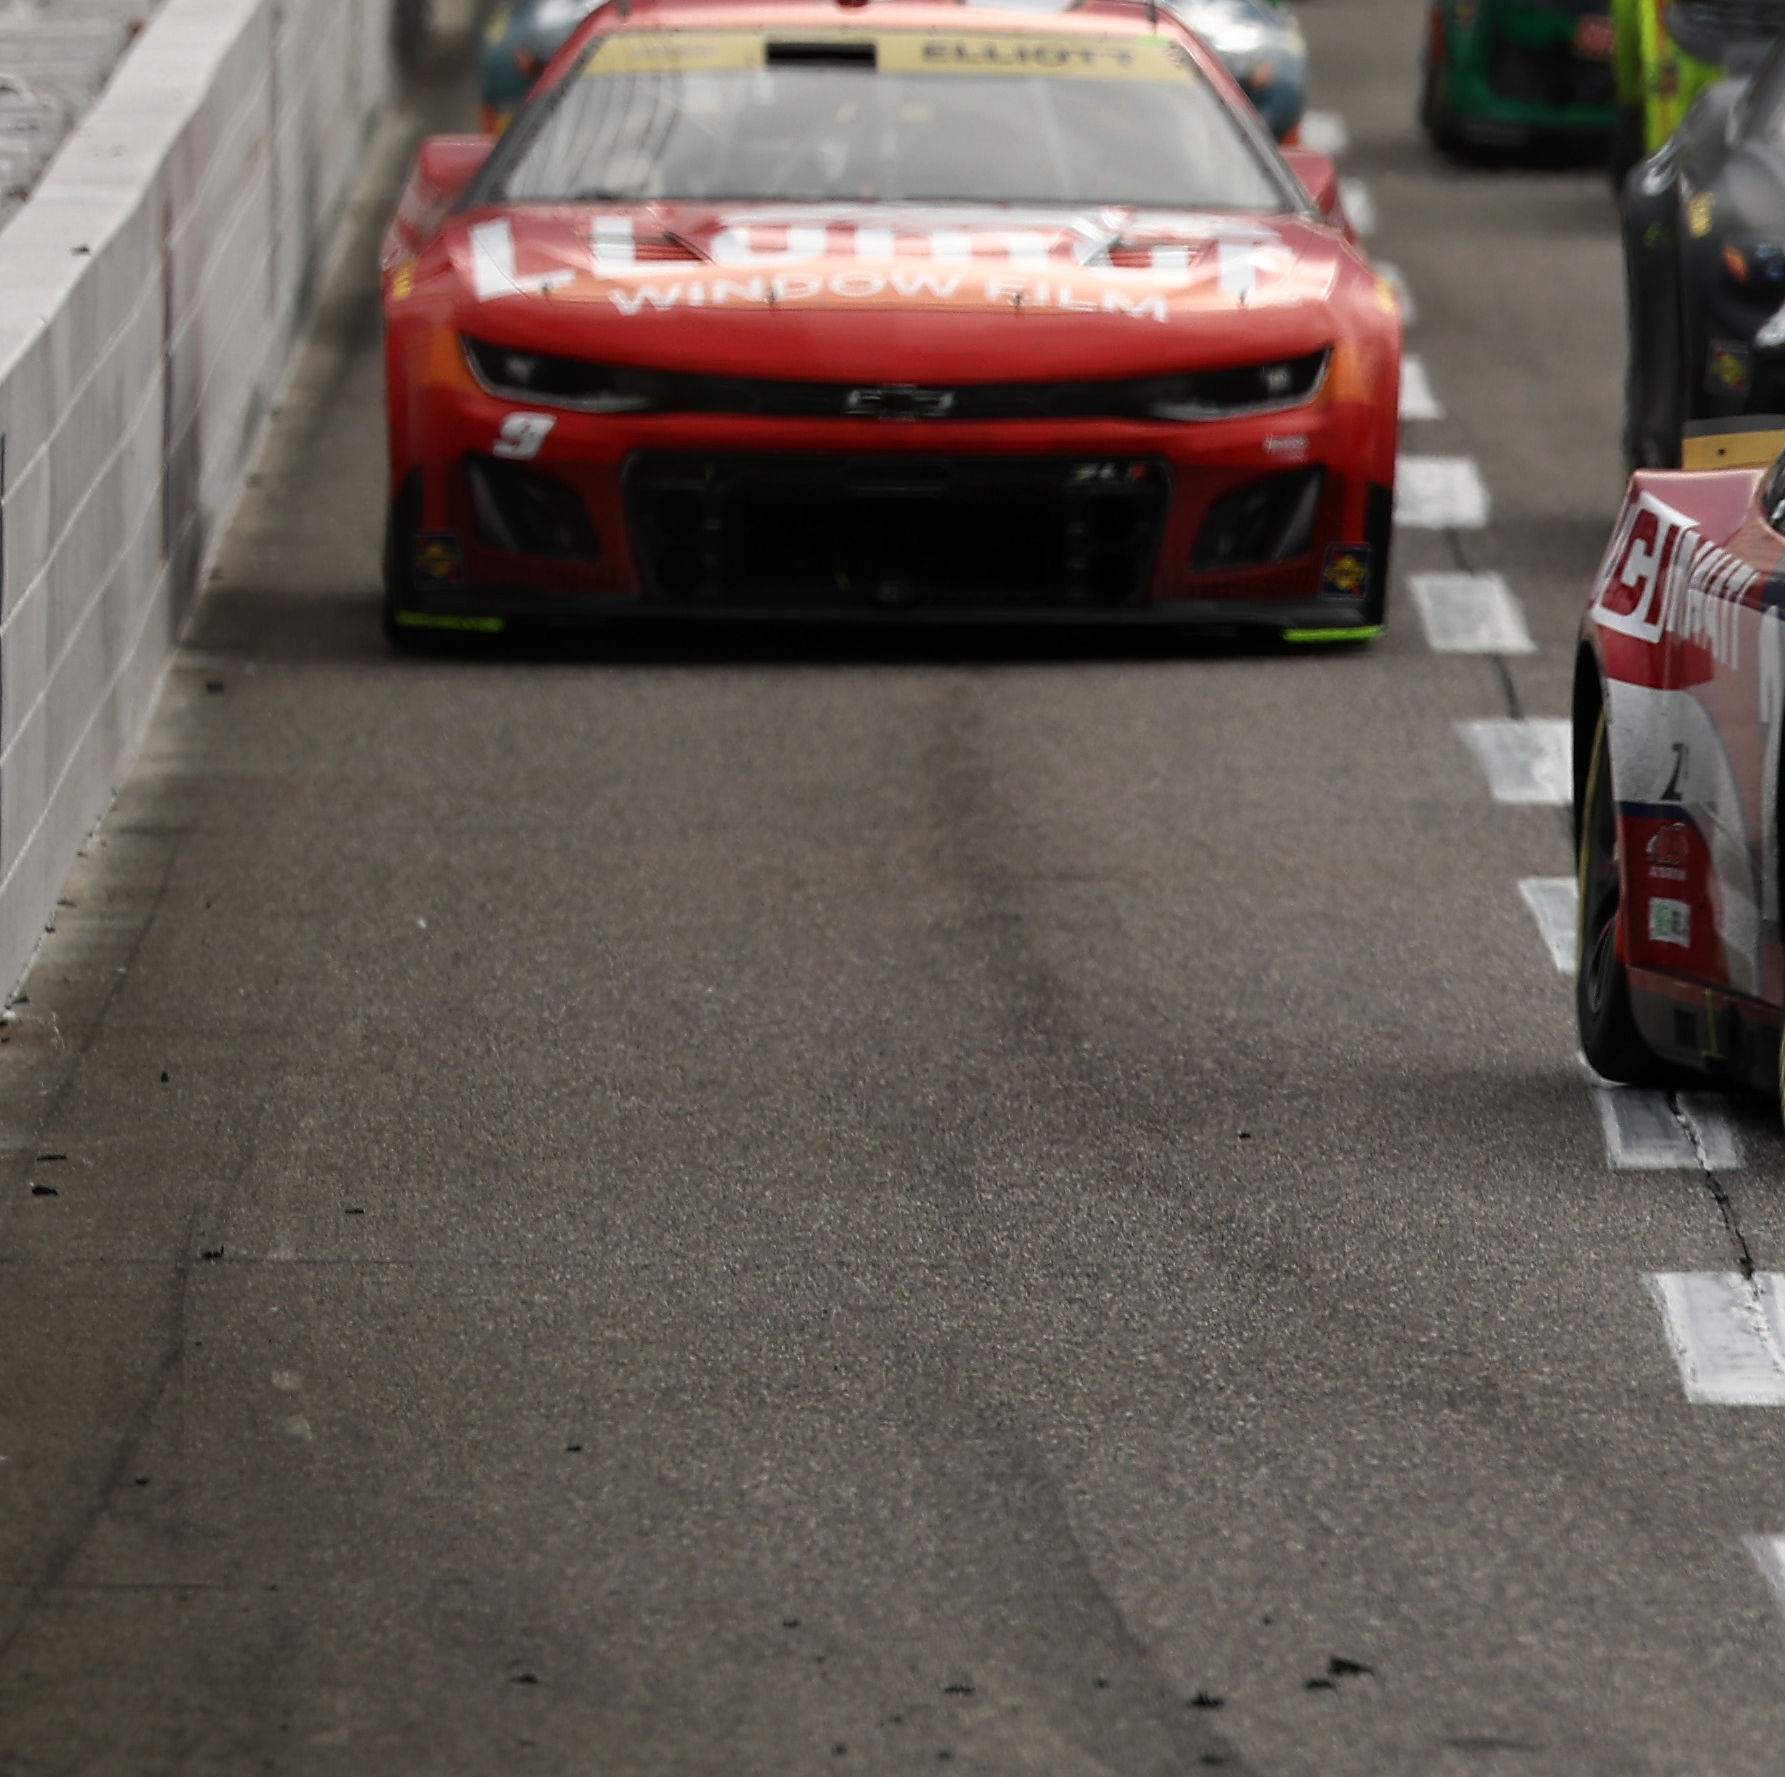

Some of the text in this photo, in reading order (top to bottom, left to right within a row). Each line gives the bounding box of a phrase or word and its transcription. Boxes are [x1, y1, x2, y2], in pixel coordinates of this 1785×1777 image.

[922, 44, 1132, 68] ELLIOTT
[609, 270, 1168, 323] WINDOW FILM
[492, 410, 557, 461] 9
